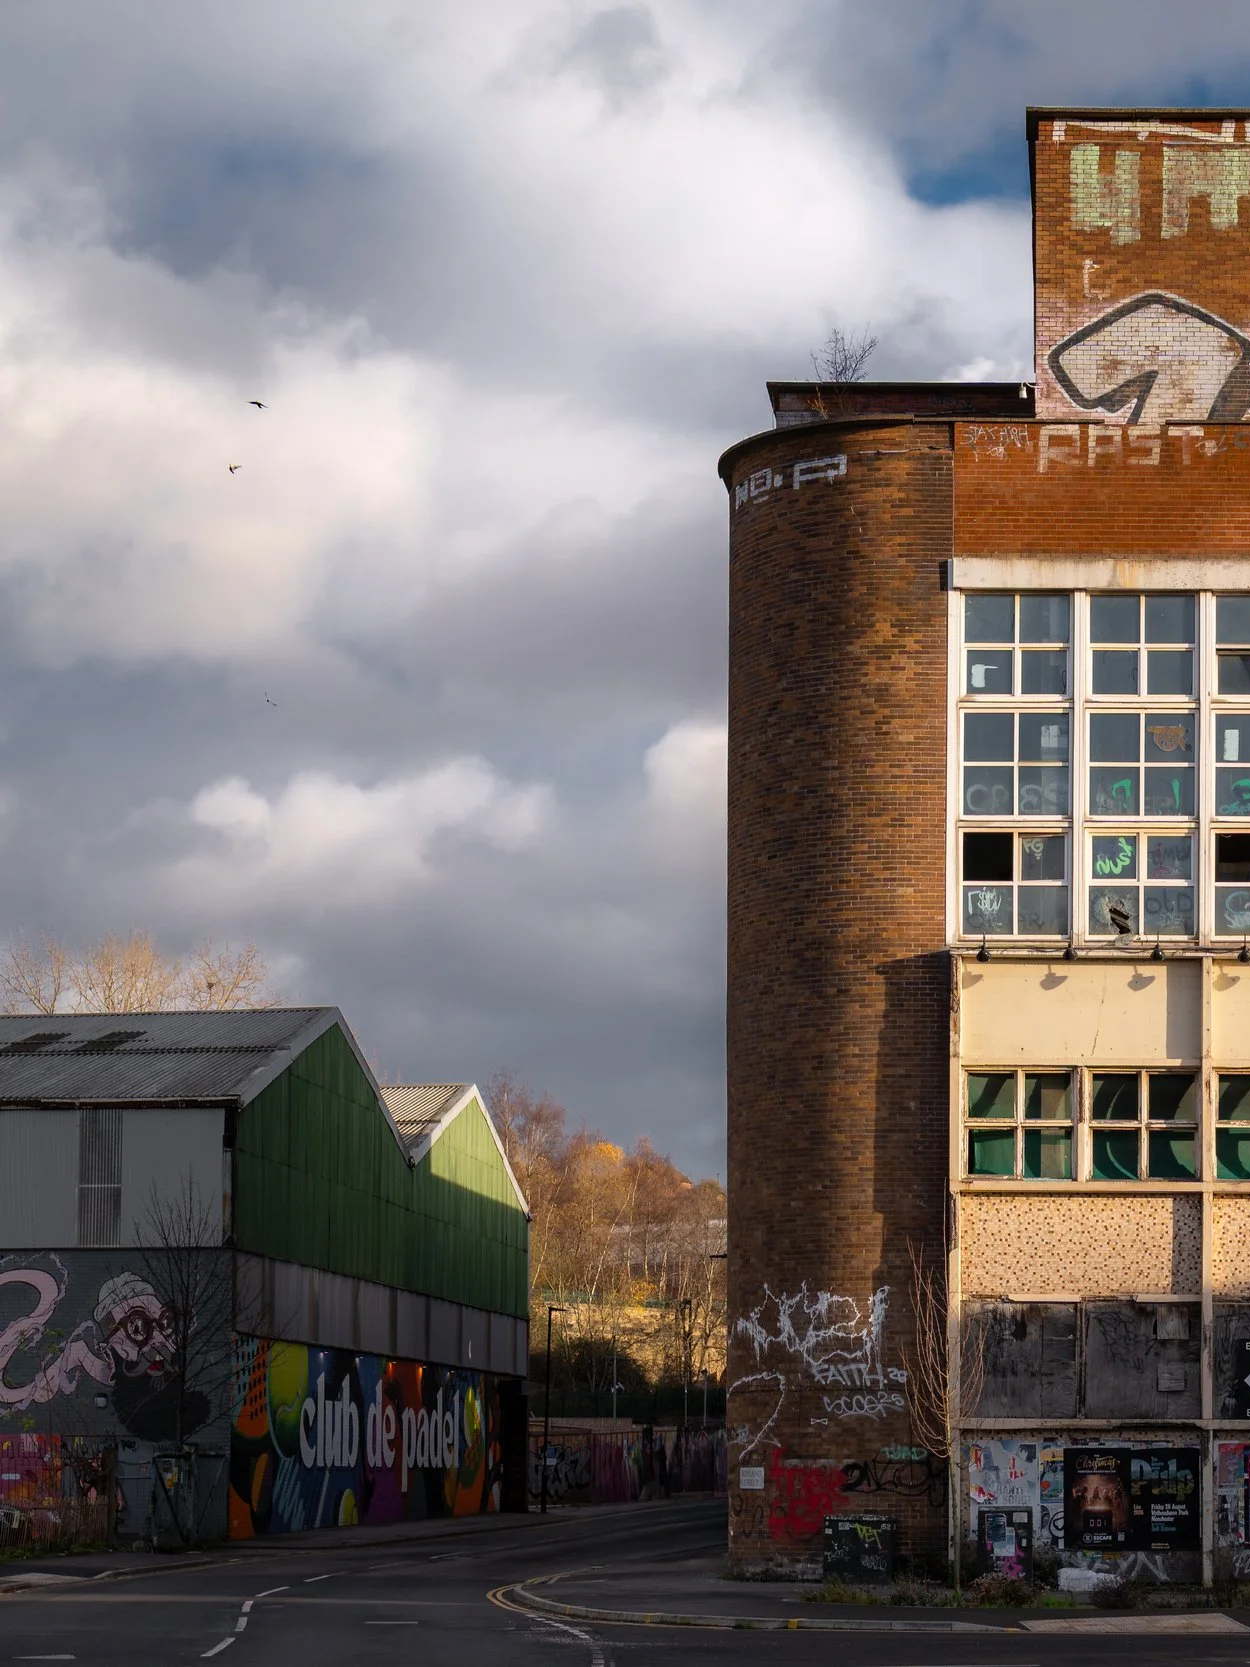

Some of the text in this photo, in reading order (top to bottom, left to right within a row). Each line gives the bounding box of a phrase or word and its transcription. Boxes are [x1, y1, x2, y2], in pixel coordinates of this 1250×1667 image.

[300, 1372, 459, 1492] club de padel
